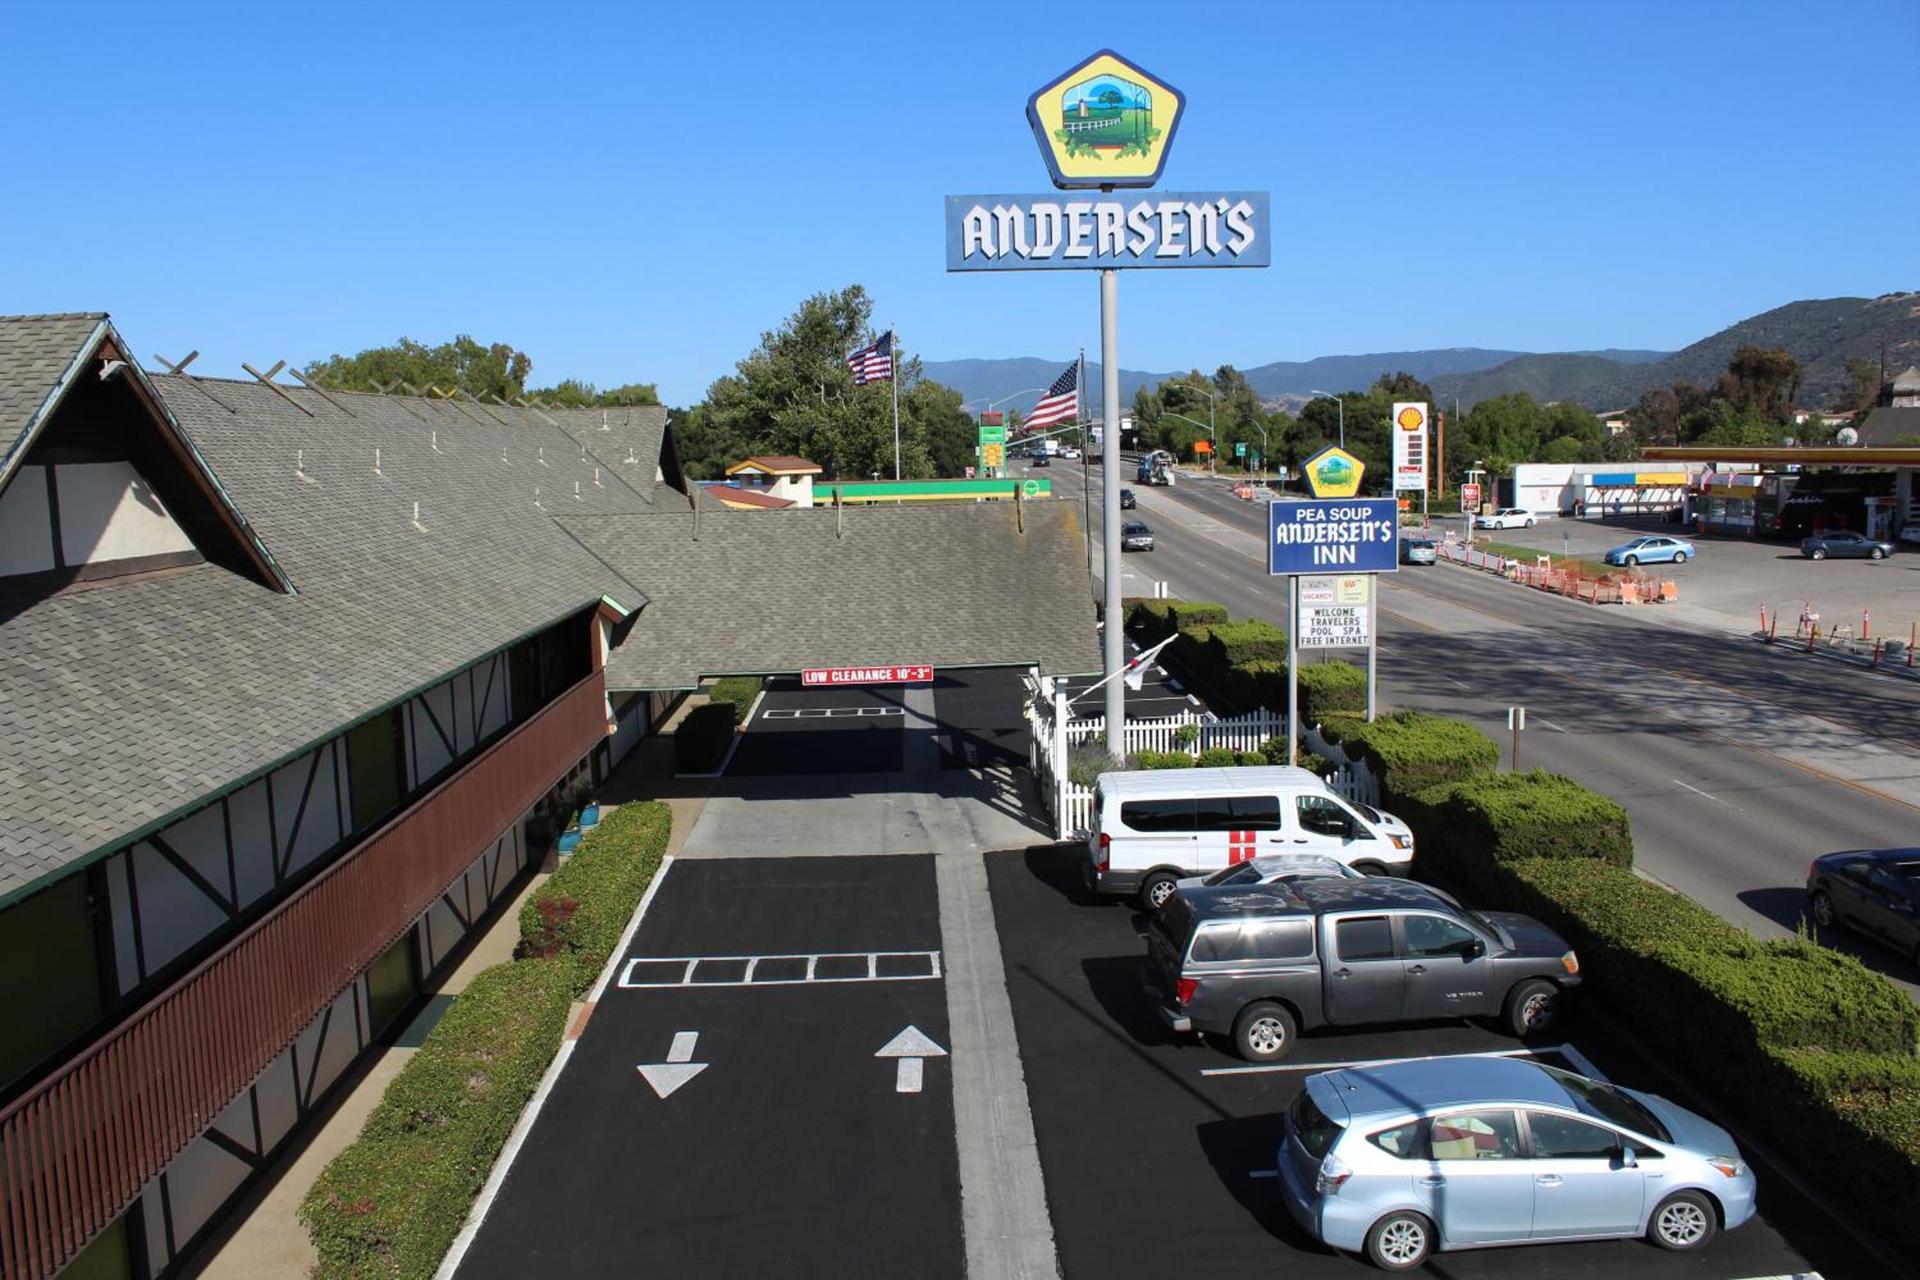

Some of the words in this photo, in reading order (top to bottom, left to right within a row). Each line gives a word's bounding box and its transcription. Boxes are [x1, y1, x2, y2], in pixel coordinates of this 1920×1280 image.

[963, 198, 1256, 260] ANDERSEN'S
[1296, 508, 1326, 521] PEA
[1330, 507, 1372, 520] SOUP
[1277, 520, 1391, 544] ANDERSEN'S
[1314, 544, 1356, 565] INN
[1303, 593, 1332, 601] VACANCY
[1314, 607, 1355, 617] WELCOME
[1311, 617, 1360, 627] TRAVELERS
[1311, 627, 1332, 636] POOL
[1343, 626, 1361, 635] SPA
[1301, 637, 1322, 646] FREE
[1325, 635, 1368, 645] INTERNET
[805, 671, 827, 683] LOW
[832, 669, 892, 682] CLEARANCE
